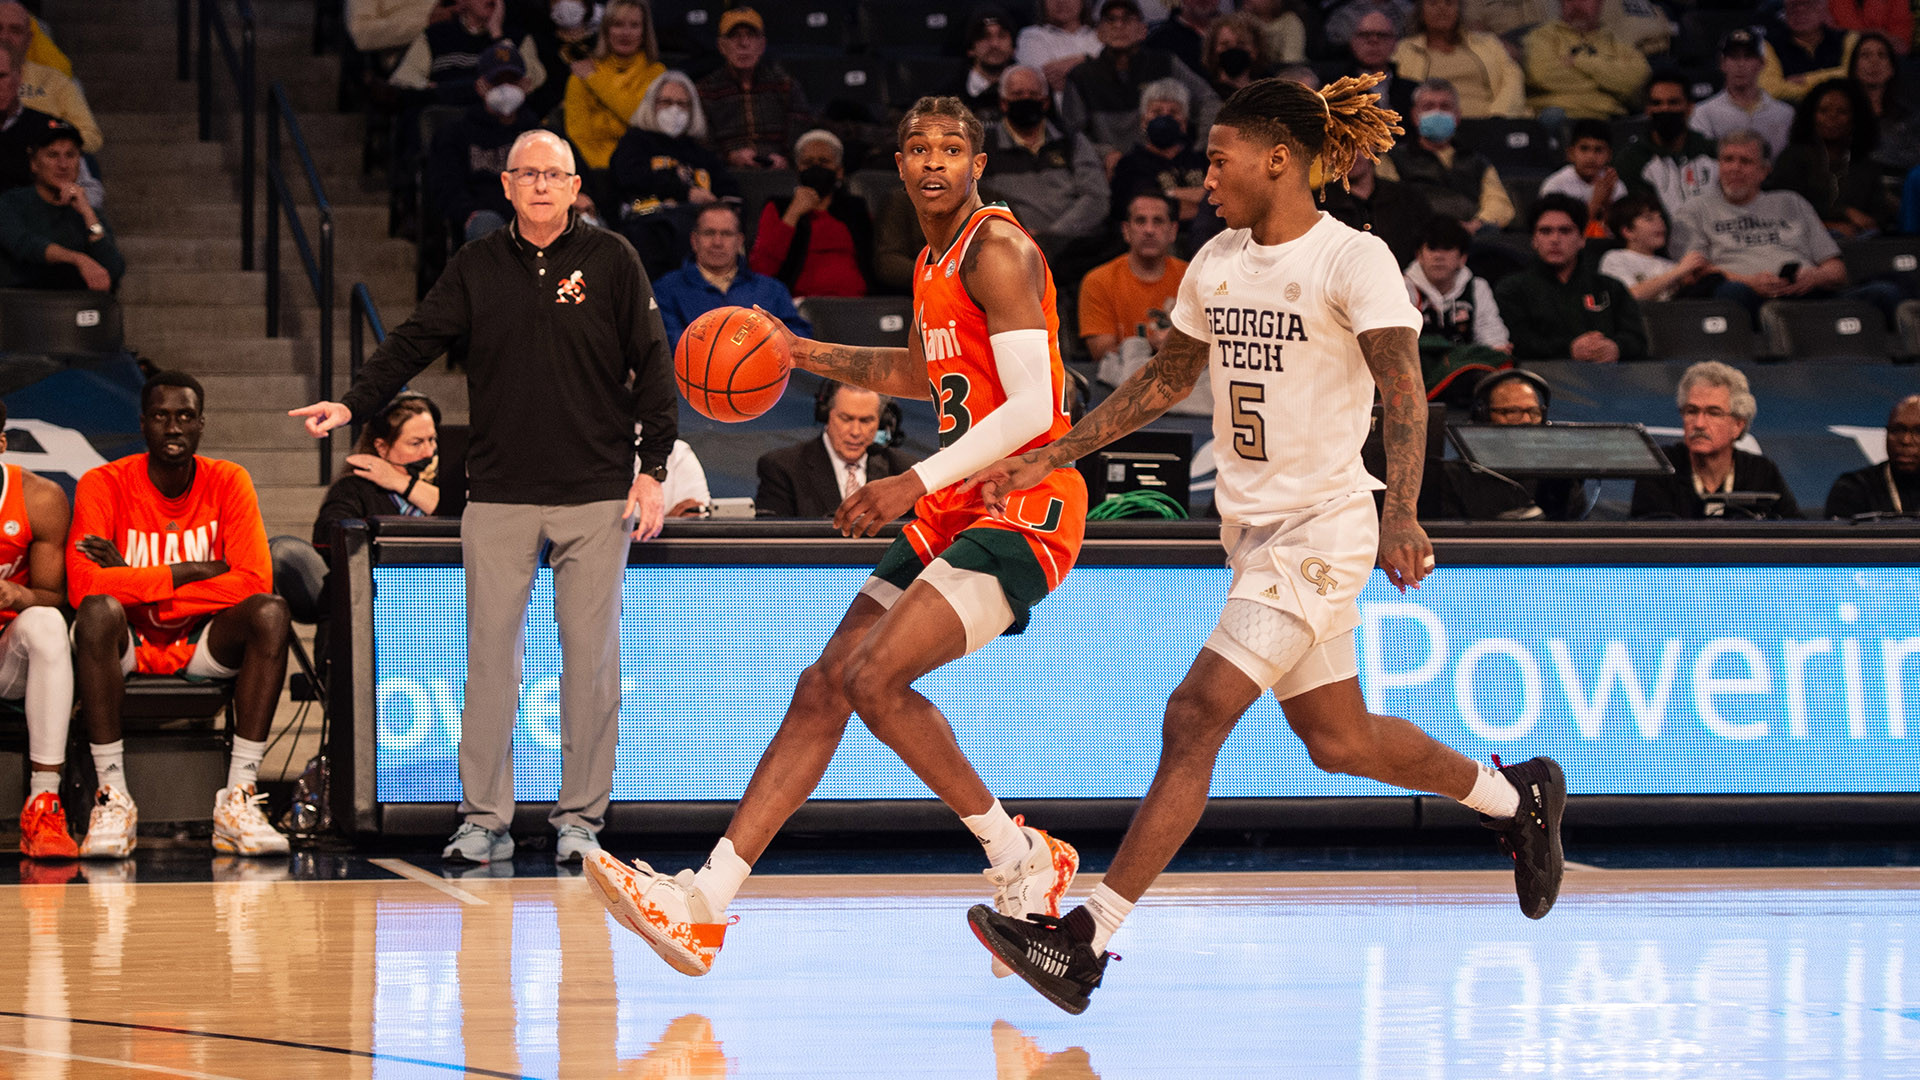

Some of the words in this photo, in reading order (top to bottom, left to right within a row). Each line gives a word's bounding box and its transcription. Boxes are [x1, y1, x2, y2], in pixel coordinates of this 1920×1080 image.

[1204, 307, 1309, 343] GEORGIA
[1217, 339, 1284, 373] TECH
[1229, 380, 1269, 462] 5
[1002, 495, 1065, 534] U
[124, 520, 218, 568] MIAMI
